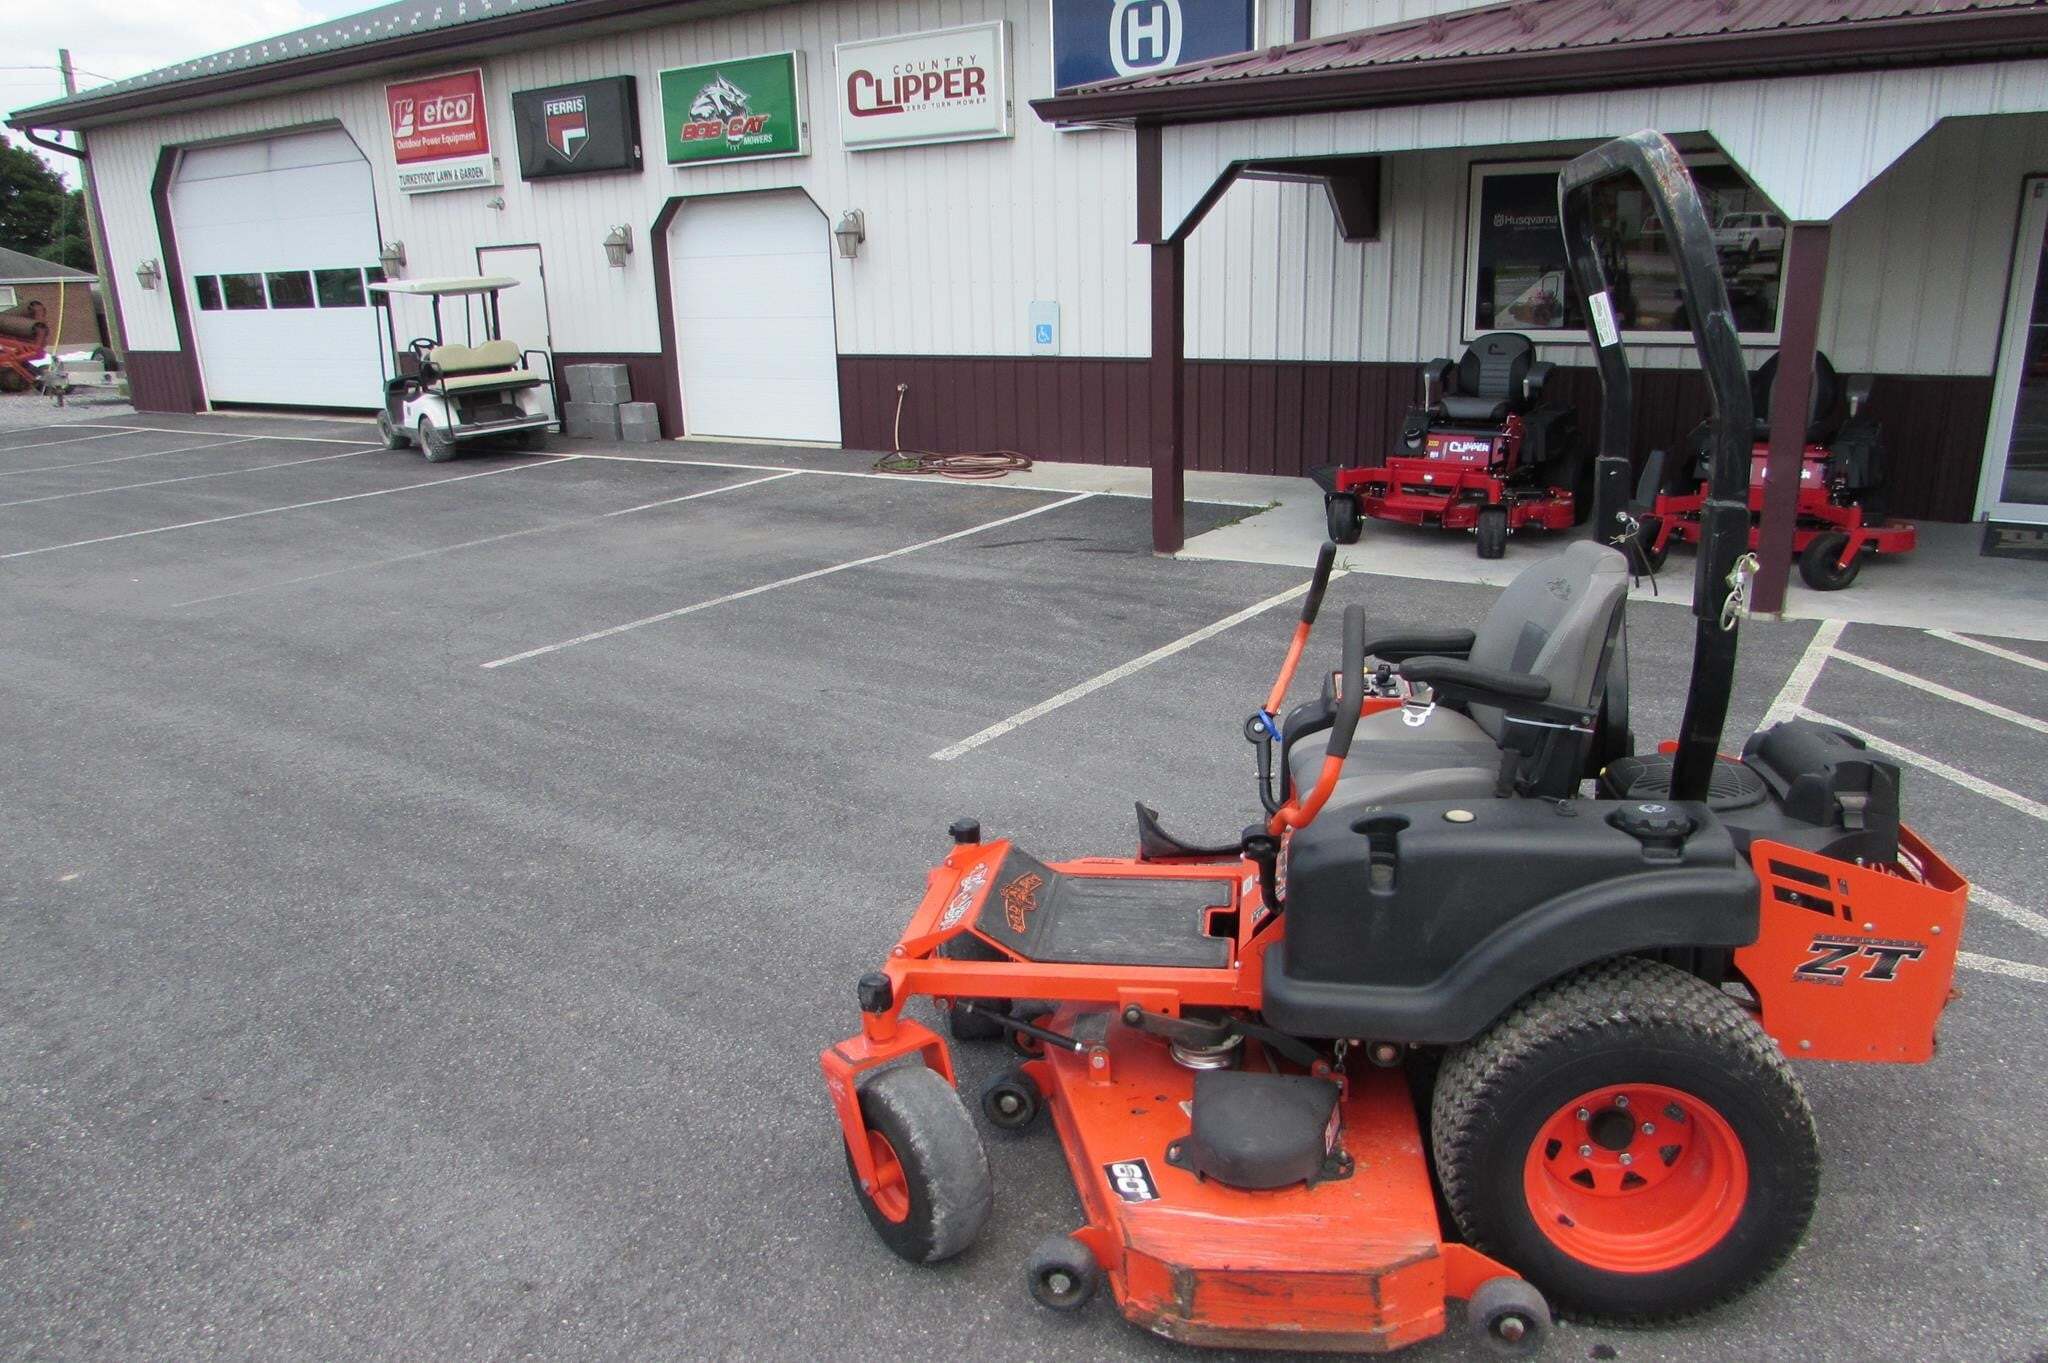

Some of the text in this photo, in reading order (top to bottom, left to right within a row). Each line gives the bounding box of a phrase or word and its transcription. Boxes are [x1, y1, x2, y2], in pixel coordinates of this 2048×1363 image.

[893, 54, 977, 75] COUNTRY
[847, 66, 986, 118] CLIPPER
[424, 97, 468, 122] efco
[546, 99, 585, 116] FERRIS
[906, 104, 928, 112] ZERO
[931, 101, 952, 109] TURN
[681, 113, 772, 143] BOB-CAT
[397, 132, 476, 149] Outdoor Power Equipment
[743, 133, 774, 146] MOWERS
[399, 172, 435, 186] TURKEYFOOT
[436, 169, 453, 181] LAWN
[460, 168, 484, 179] GARDEN
[1793, 940, 1926, 982] ZT
